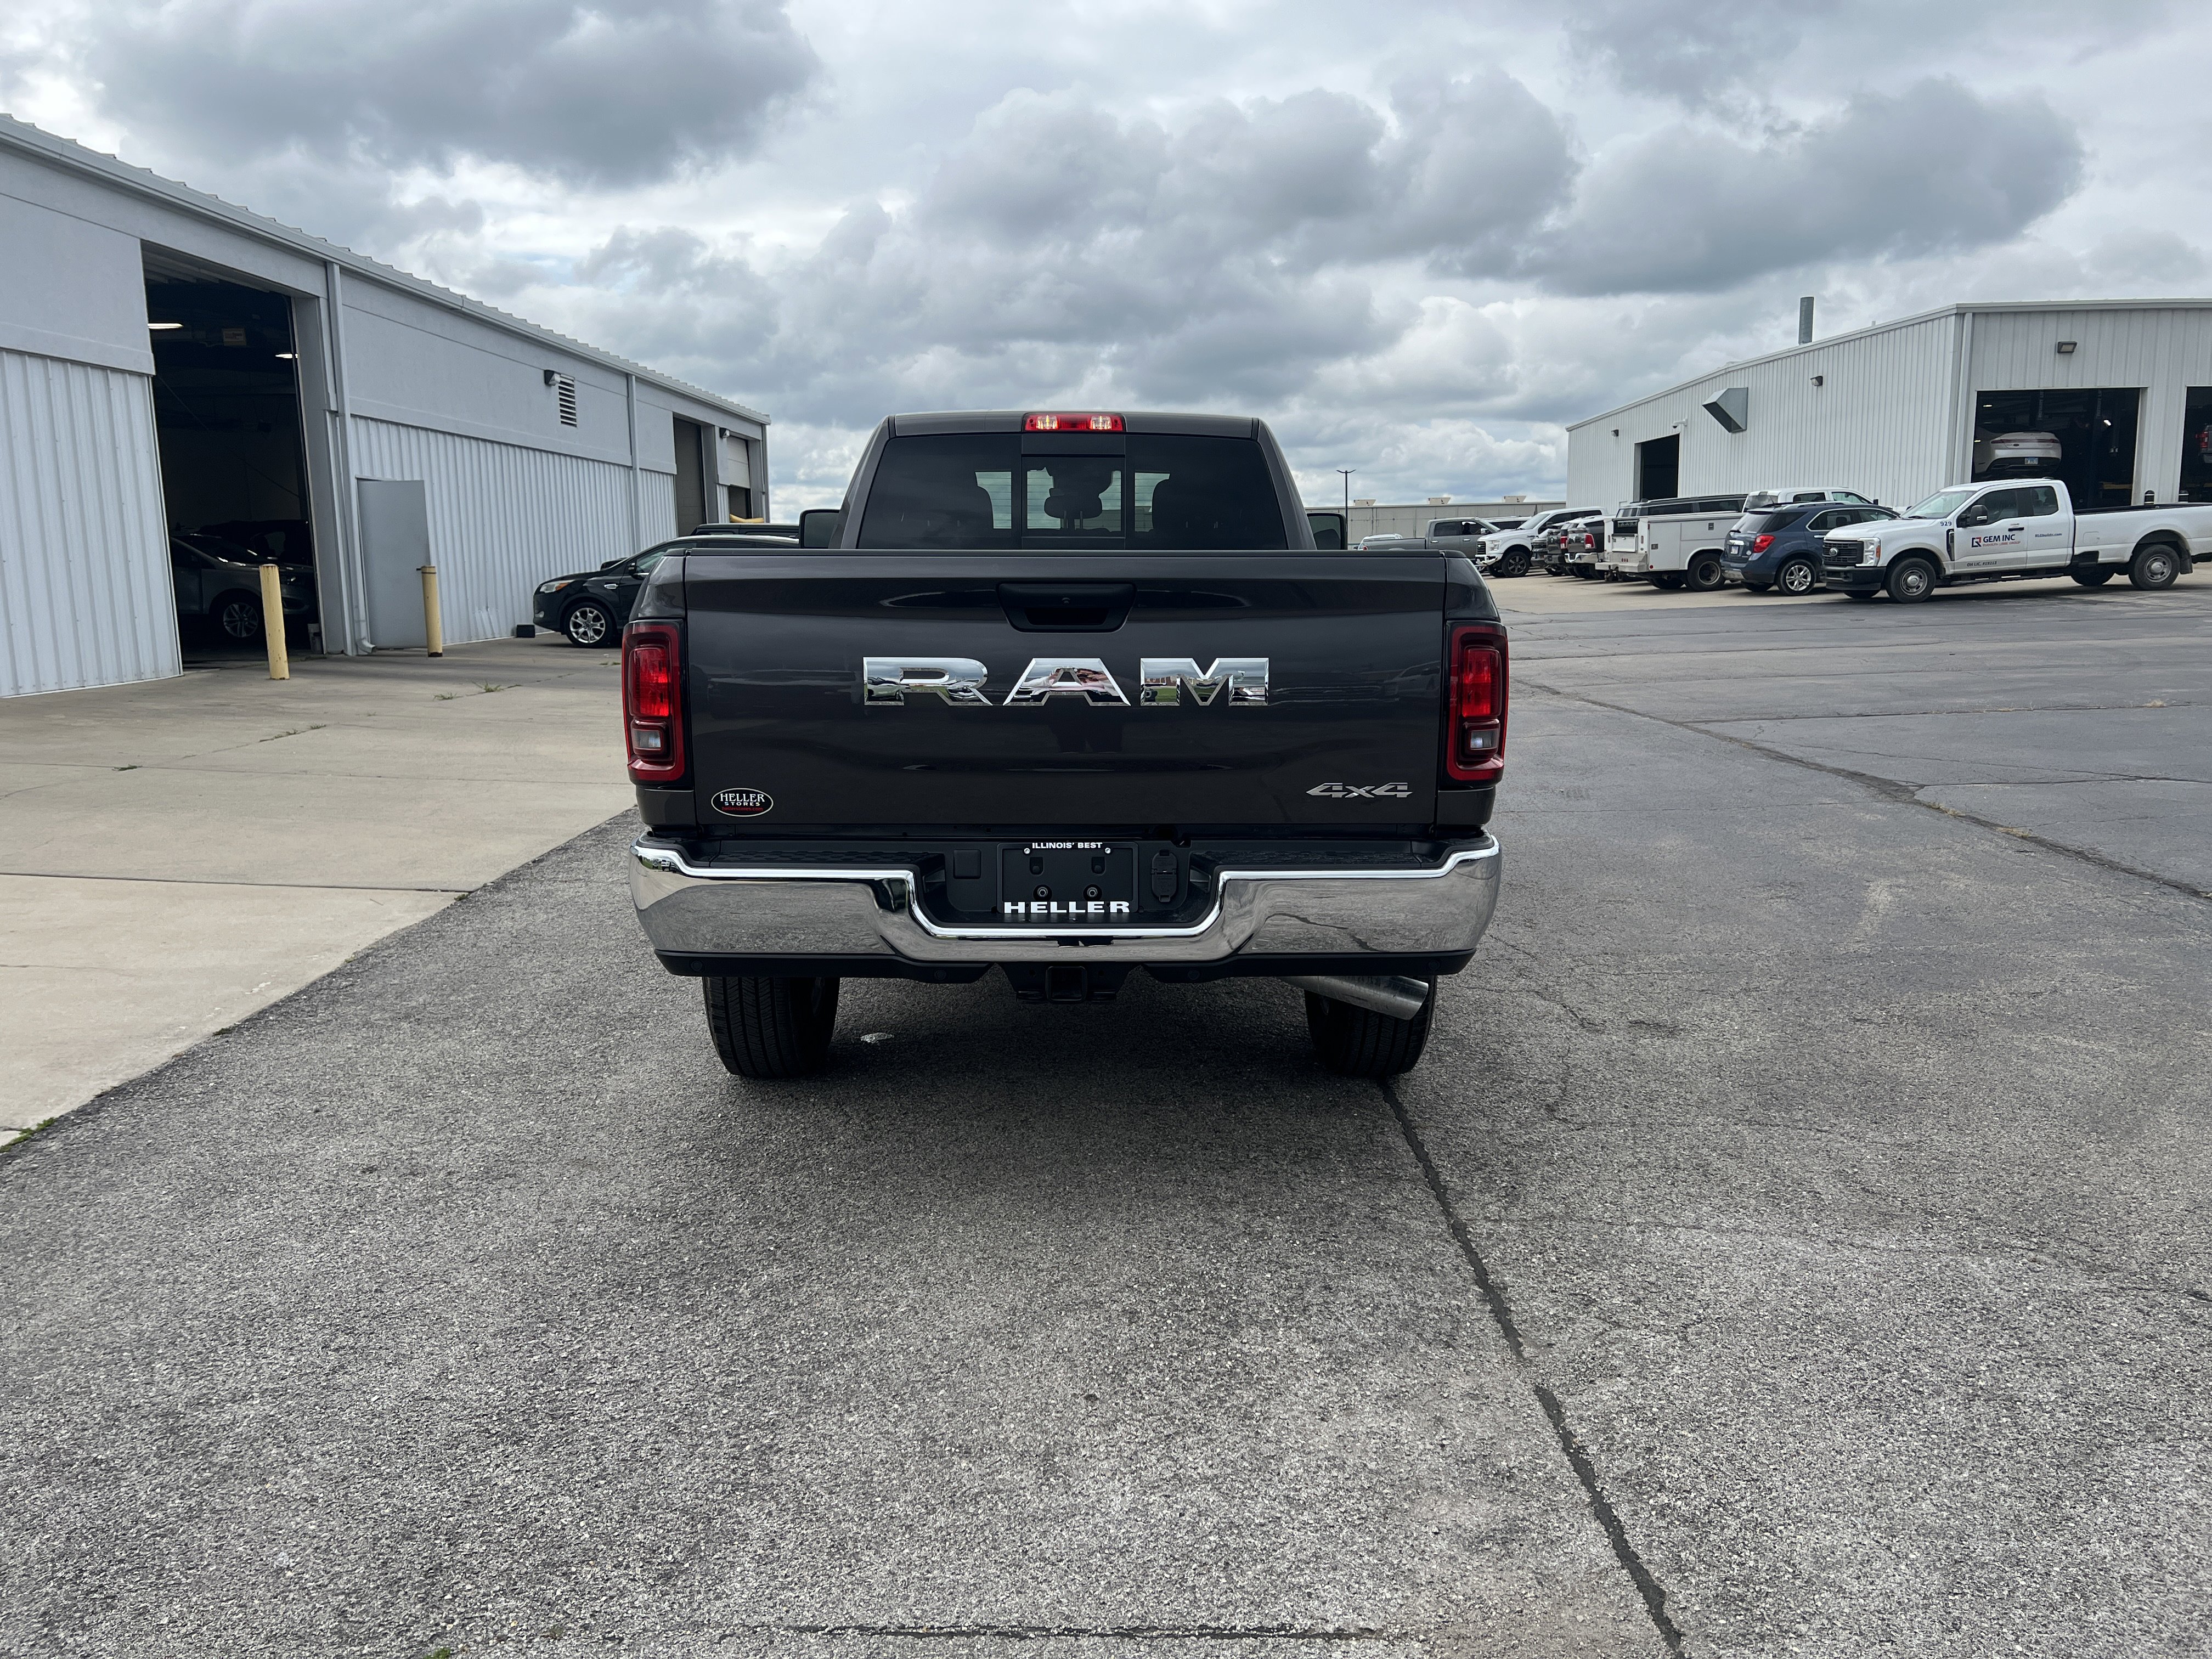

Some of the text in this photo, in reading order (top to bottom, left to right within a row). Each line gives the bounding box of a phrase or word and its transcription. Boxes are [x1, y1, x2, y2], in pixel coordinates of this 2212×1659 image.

[863, 657, 1269, 707] RAM
[1306, 782, 1413, 798] 4x4
[720, 793, 765, 802] HELLER
[1004, 901, 1130, 913] HELLER
